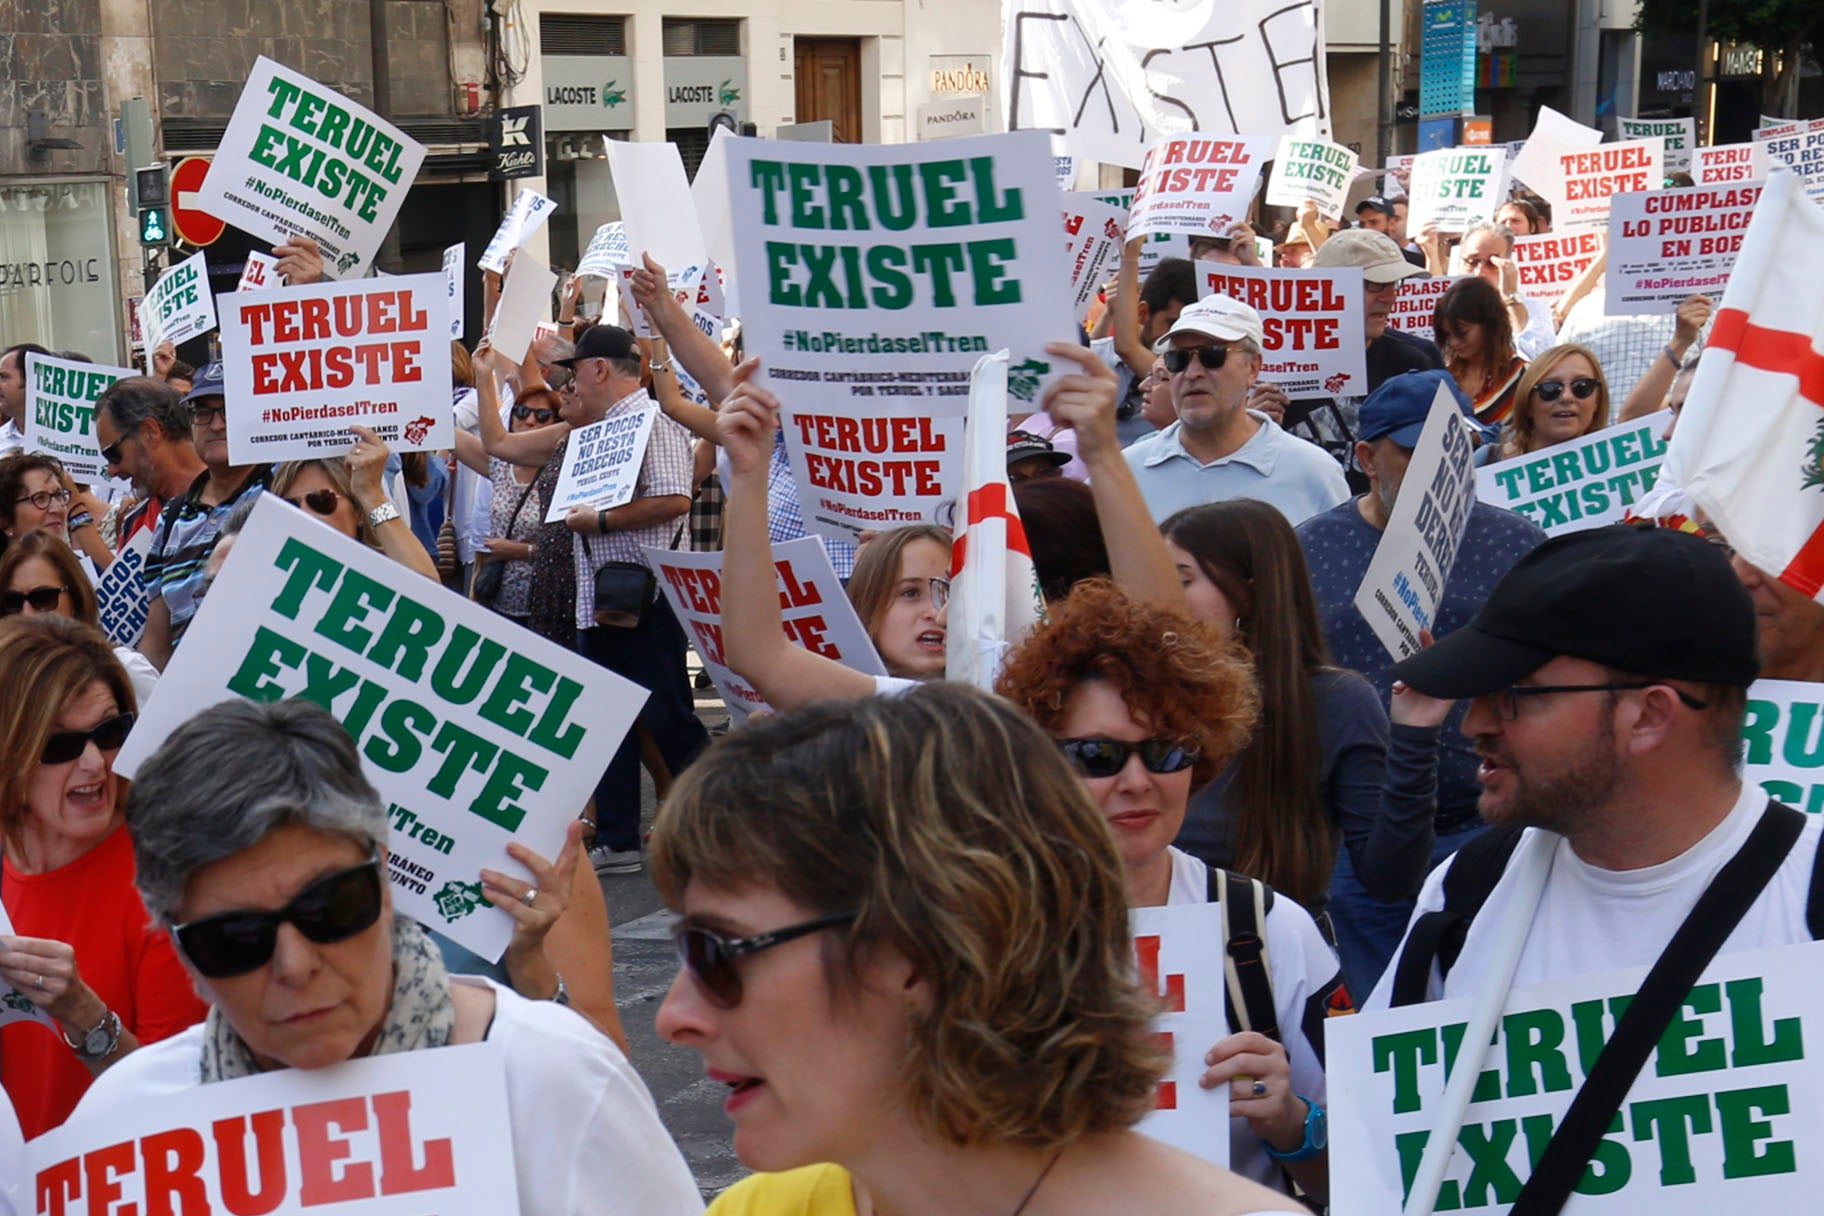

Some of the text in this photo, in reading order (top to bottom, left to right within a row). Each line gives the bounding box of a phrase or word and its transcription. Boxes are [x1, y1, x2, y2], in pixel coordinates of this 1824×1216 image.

[547, 86, 596, 105] LACOSTE
[669, 85, 713, 103] LACOSTE
[266, 76, 403, 185] TERUEL
[1623, 122, 1686, 136] TERUEL
[1289, 142, 1351, 172] TERUEL
[1560, 146, 1652, 176] TERUEL
[1701, 148, 1752, 167] TERU
[1768, 139, 1800, 154] SER
[248, 124, 387, 224] EXISTE
[1285, 161, 1346, 190] EXISTE
[1565, 171, 1647, 201] EXISTE
[244, 176, 351, 240] #NoPierdaselTren
[749, 156, 1025, 231] TERUEL
[1623, 220, 1651, 238] LO
[1513, 233, 1596, 263] TERUE
[1661, 235, 1745, 258] EN BOE
[765, 238, 1022, 310] EXISTE
[1520, 257, 1593, 285] EXIST
[1635, 273, 1730, 289] #NoPierdaselT
[1207, 273, 1345, 312] TERUEL
[240, 290, 428, 346] TERUEL
[694, 313, 714, 336] COS
[783, 330, 989, 354] #NoPierdaselTren
[1262, 318, 1340, 351] STE
[252, 340, 422, 395] EXISTE
[937, 385, 969, 396] SAGU
[35, 396, 95, 436] EXIST
[262, 401, 398, 424] #NoPierdaselTren
[250, 434, 288, 444] CORREDOR
[308, 440, 322, 448] POR
[323, 438, 352, 447] TERUEL
[579, 413, 645, 445] SER POCOS
[793, 414, 945, 454] TERUEL
[577, 432, 636, 461] NO RESTA
[572, 447, 634, 478] DERECHOS
[599, 468, 621, 481] EXISTE
[805, 452, 942, 496] EXISTE
[1494, 427, 1668, 501] TERUEL
[820, 499, 921, 521] #NoPierdaselTren
[97, 546, 142, 611] OCOS
[660, 560, 823, 614] TERL
[270, 536, 587, 760] TERUEL
[226, 625, 550, 834] EXISTE
